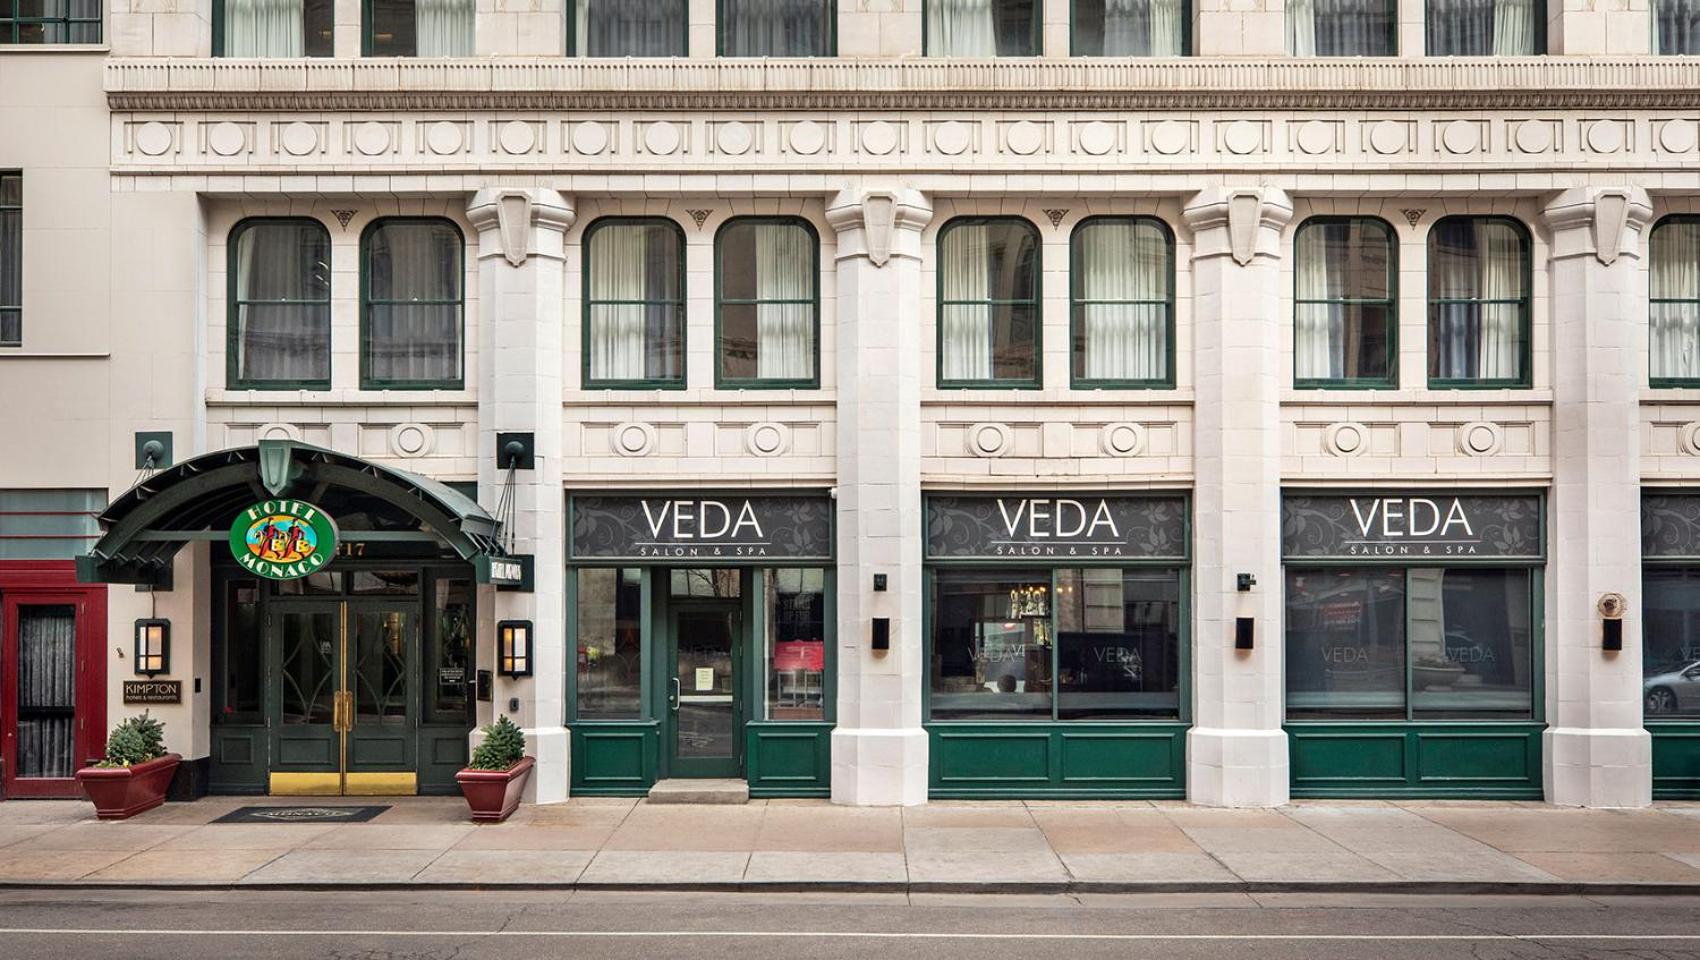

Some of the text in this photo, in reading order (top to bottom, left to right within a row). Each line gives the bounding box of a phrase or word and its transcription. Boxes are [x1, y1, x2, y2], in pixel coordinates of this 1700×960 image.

[247, 500, 316, 522] HOTEL
[641, 500, 763, 538] VEDA
[997, 498, 1119, 537] VEDA
[1350, 497, 1473, 536] VEDA
[640, 547, 766, 556] SALON & SPA
[996, 546, 1122, 556] SALON & SPA
[1350, 545, 1476, 555] SALON & SPA
[240, 552, 324, 578] MONACO
[1322, 646, 1369, 664] VEDA
[1449, 646, 1496, 664] VEDA
[126, 684, 177, 694] KIMPTON
